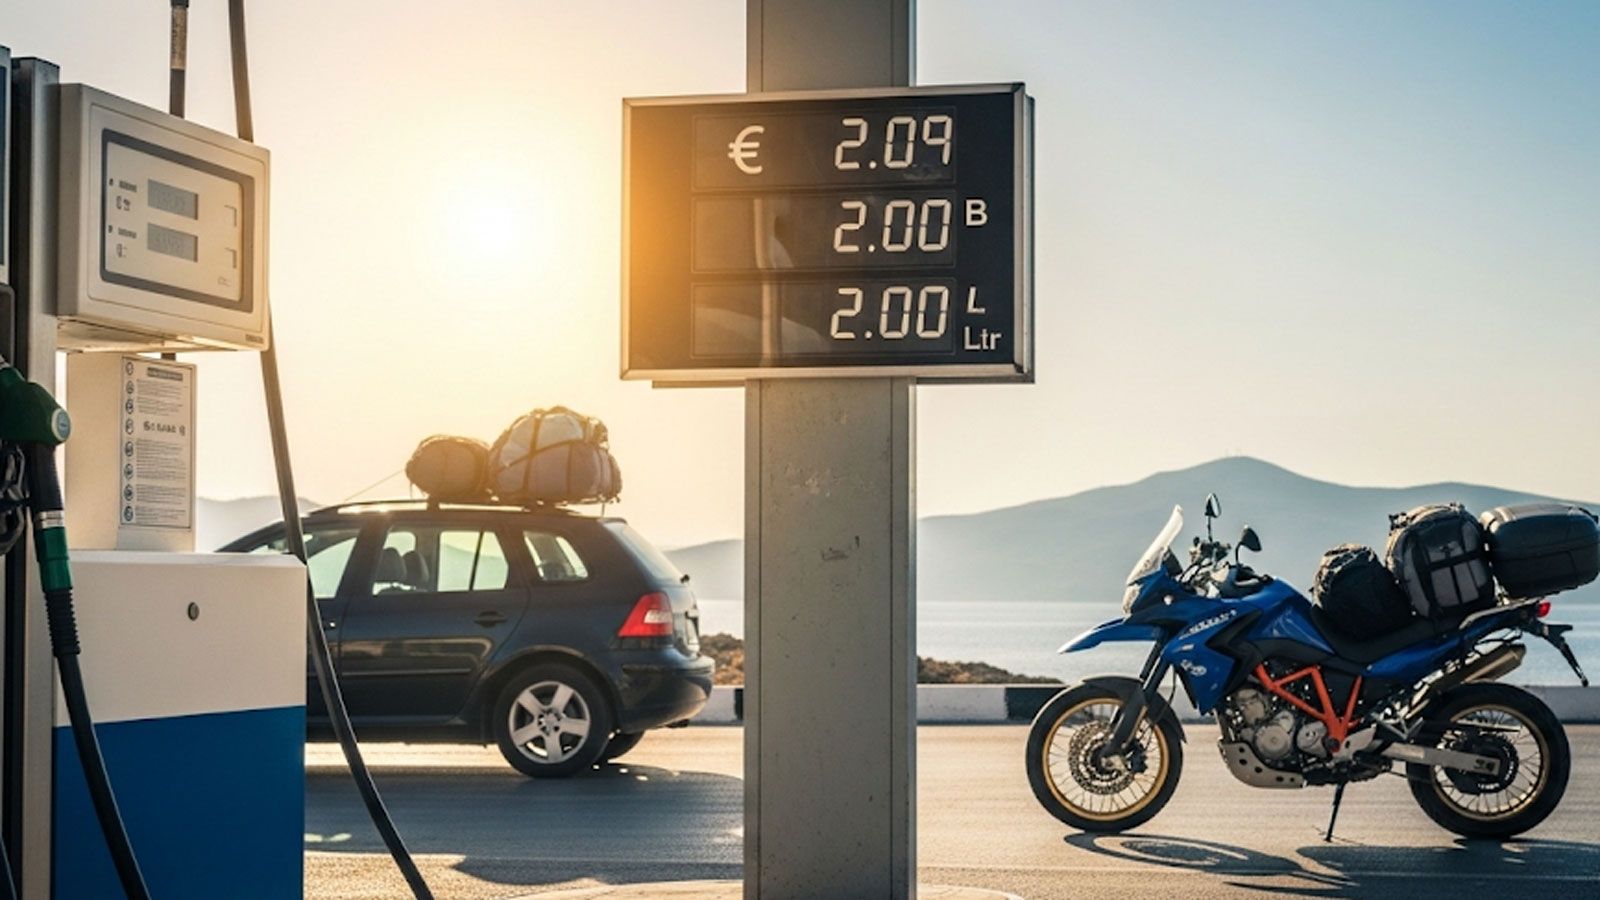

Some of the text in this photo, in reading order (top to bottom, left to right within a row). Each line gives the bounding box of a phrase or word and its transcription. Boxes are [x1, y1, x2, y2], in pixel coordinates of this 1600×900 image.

[728, 115, 952, 174] € 2.09
[833, 199, 988, 253] 2.00 B
[830, 285, 986, 340] 2.00 L
[964, 326, 1002, 351] Ltr
